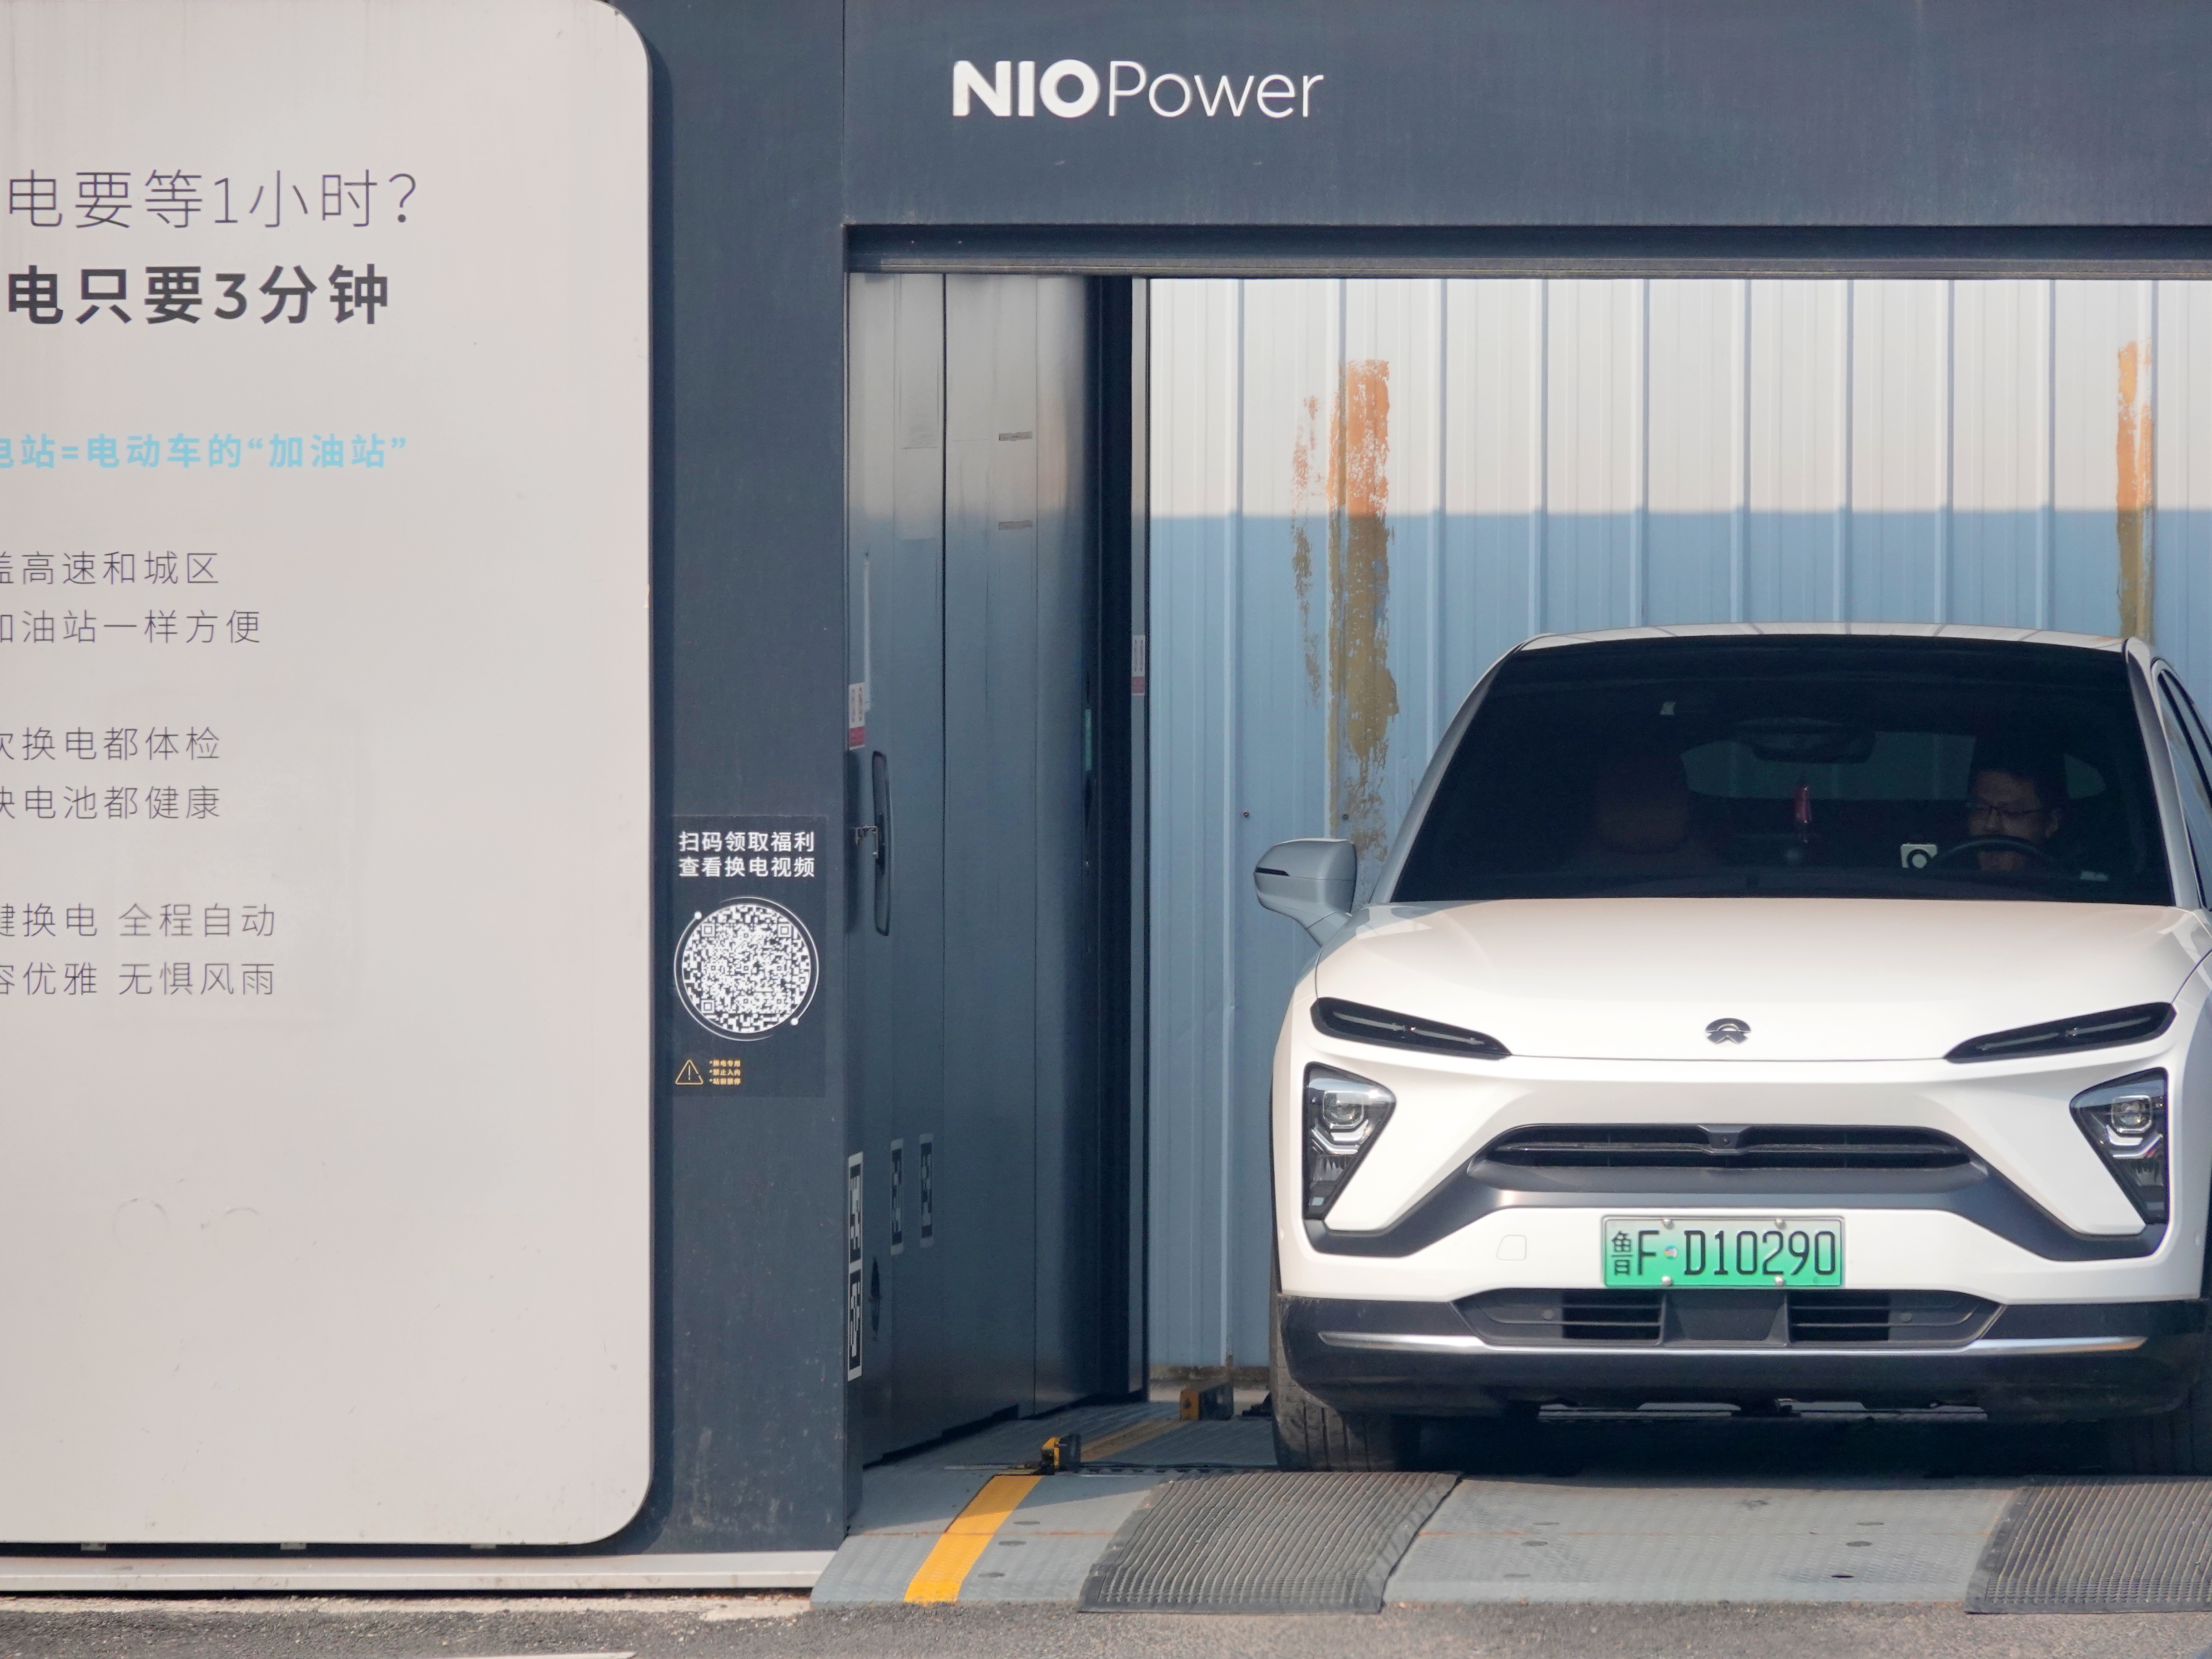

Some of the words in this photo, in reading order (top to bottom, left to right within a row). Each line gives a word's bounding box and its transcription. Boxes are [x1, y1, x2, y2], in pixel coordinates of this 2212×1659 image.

[9, 169, 417, 229] 电要等1小时？
[8, 264, 388, 325] 电只要3分钟
[679, 831, 814, 852] 扫码领取福利
[679, 856, 815, 878] 查看换电视频
[119, 903, 275, 937] 全程自动
[119, 962, 275, 996] 无惧风雨
